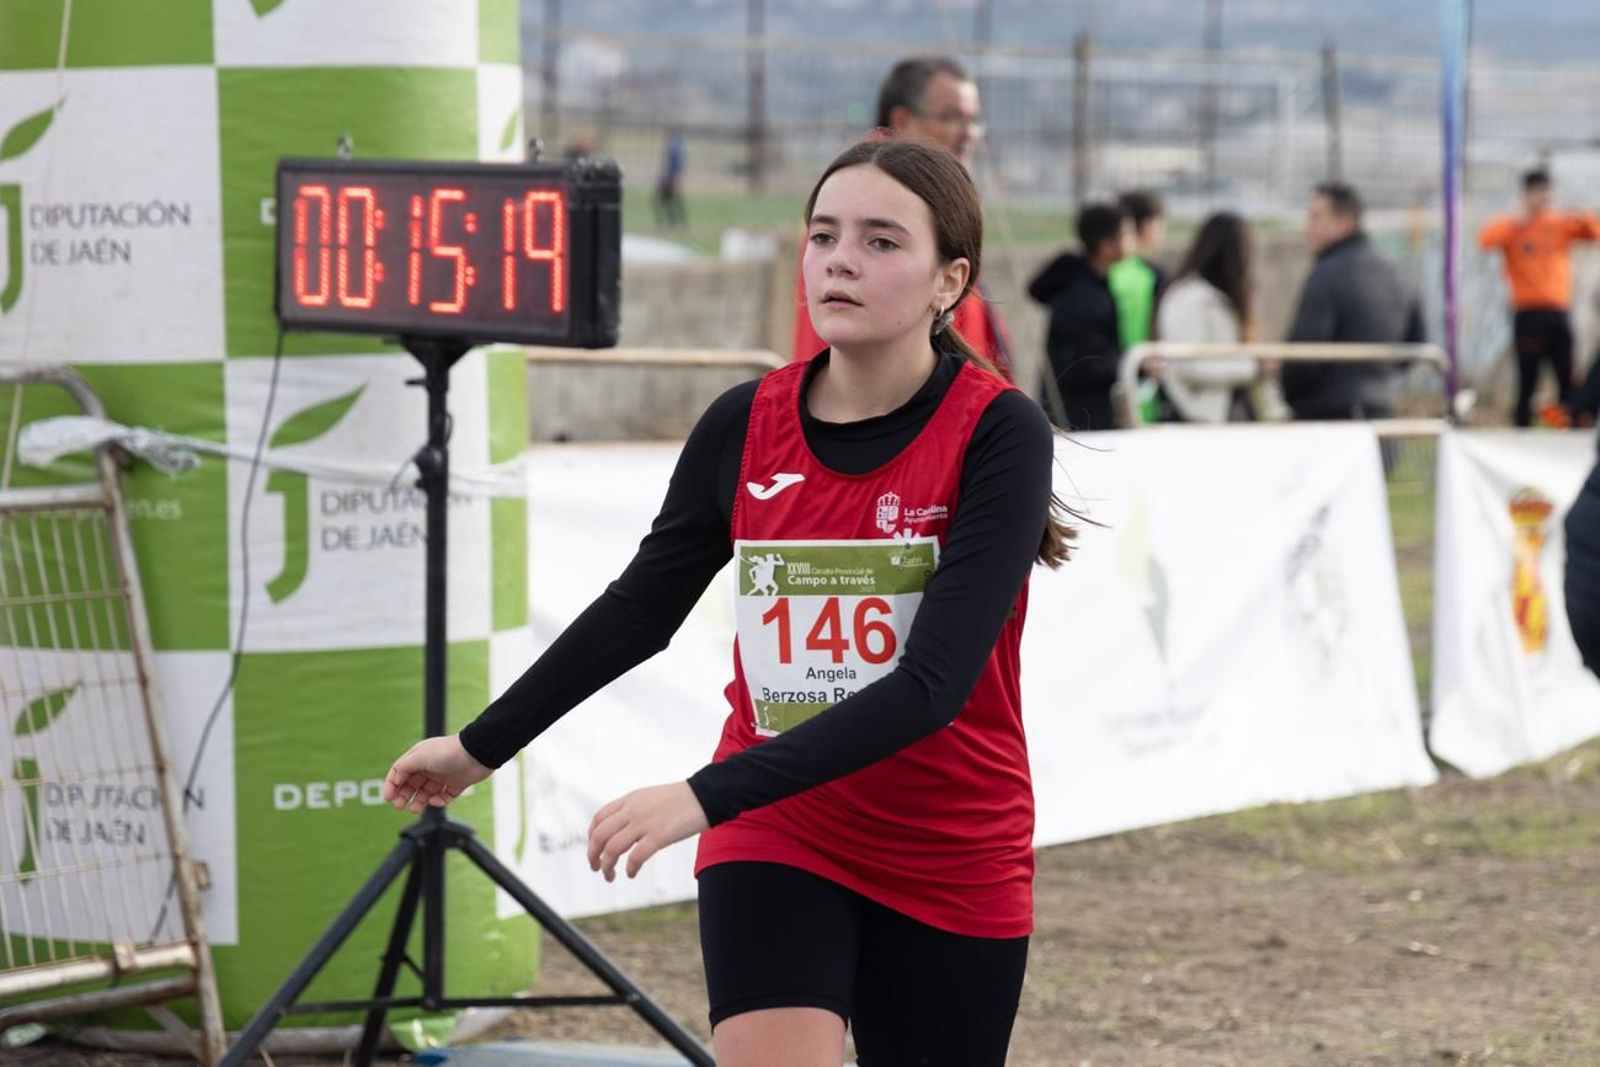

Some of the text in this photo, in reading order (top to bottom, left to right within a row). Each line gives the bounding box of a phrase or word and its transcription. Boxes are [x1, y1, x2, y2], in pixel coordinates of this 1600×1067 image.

[29, 199, 191, 229] DIPUTACIÓN
[30, 237, 131, 266] DE JAÉN
[294, 185, 564, 313] 00:15:19
[904, 507, 915, 516] La
[321, 525, 357, 551] DE
[787, 574, 876, 587] Campo a través
[762, 597, 897, 664] 146
[806, 666, 857, 683] Angela
[762, 687, 828, 703] Berzosa
